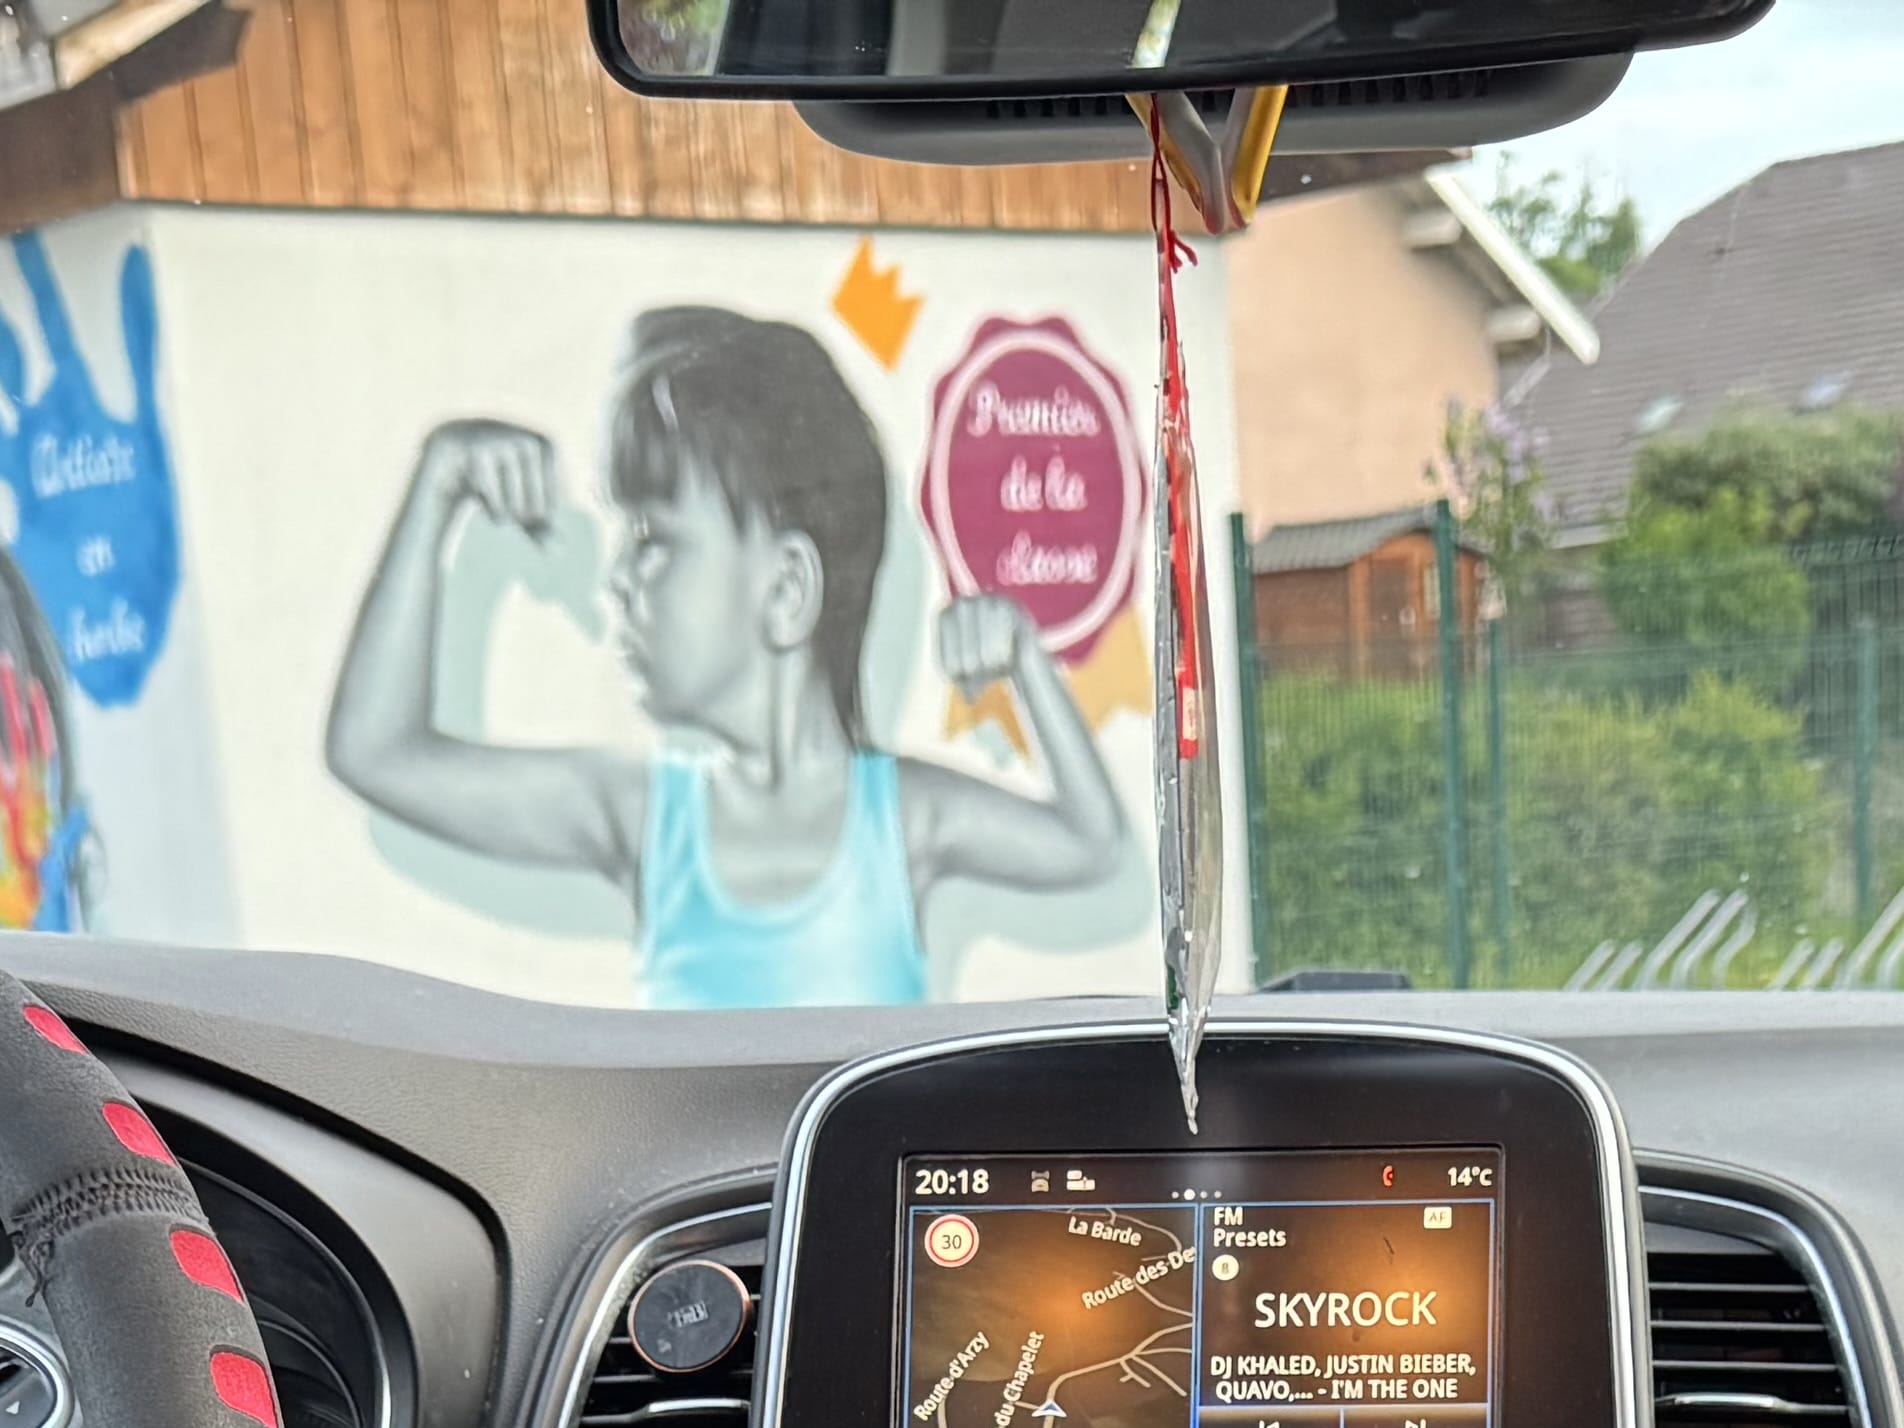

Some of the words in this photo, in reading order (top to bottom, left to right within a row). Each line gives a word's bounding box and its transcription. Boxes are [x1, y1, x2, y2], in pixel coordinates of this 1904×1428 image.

[915, 1169, 989, 1195] 20:18
[1447, 1166, 1493, 1187] 14°C
[1214, 1207, 1243, 1226] FM
[1429, 1211, 1446, 1223] AF
[941, 1235, 962, 1250] 30
[1068, 1216, 1087, 1236] La
[1091, 1223, 1142, 1246] Barde
[1213, 1228, 1287, 1248] Presets
[1081, 1276, 1135, 1309] Route
[1135, 1260, 1169, 1285] des
[1255, 1291, 1437, 1328] SKYROCK
[914, 1378, 955, 1421] Route
[949, 1332, 990, 1379] d'Arzy
[1003, 1330, 1045, 1401] Chapelet
[1210, 1356, 1233, 1379] DJ
[1237, 1355, 1322, 1377] KHALED,
[1323, 1354, 1393, 1378] JUSTIN
[1399, 1353, 1476, 1376] BIEBER,
[1331, 1379, 1363, 1399] I'M
[1368, 1379, 1408, 1399] THE
[1412, 1378, 1458, 1399] ONE
[995, 1401, 1016, 1428] du
